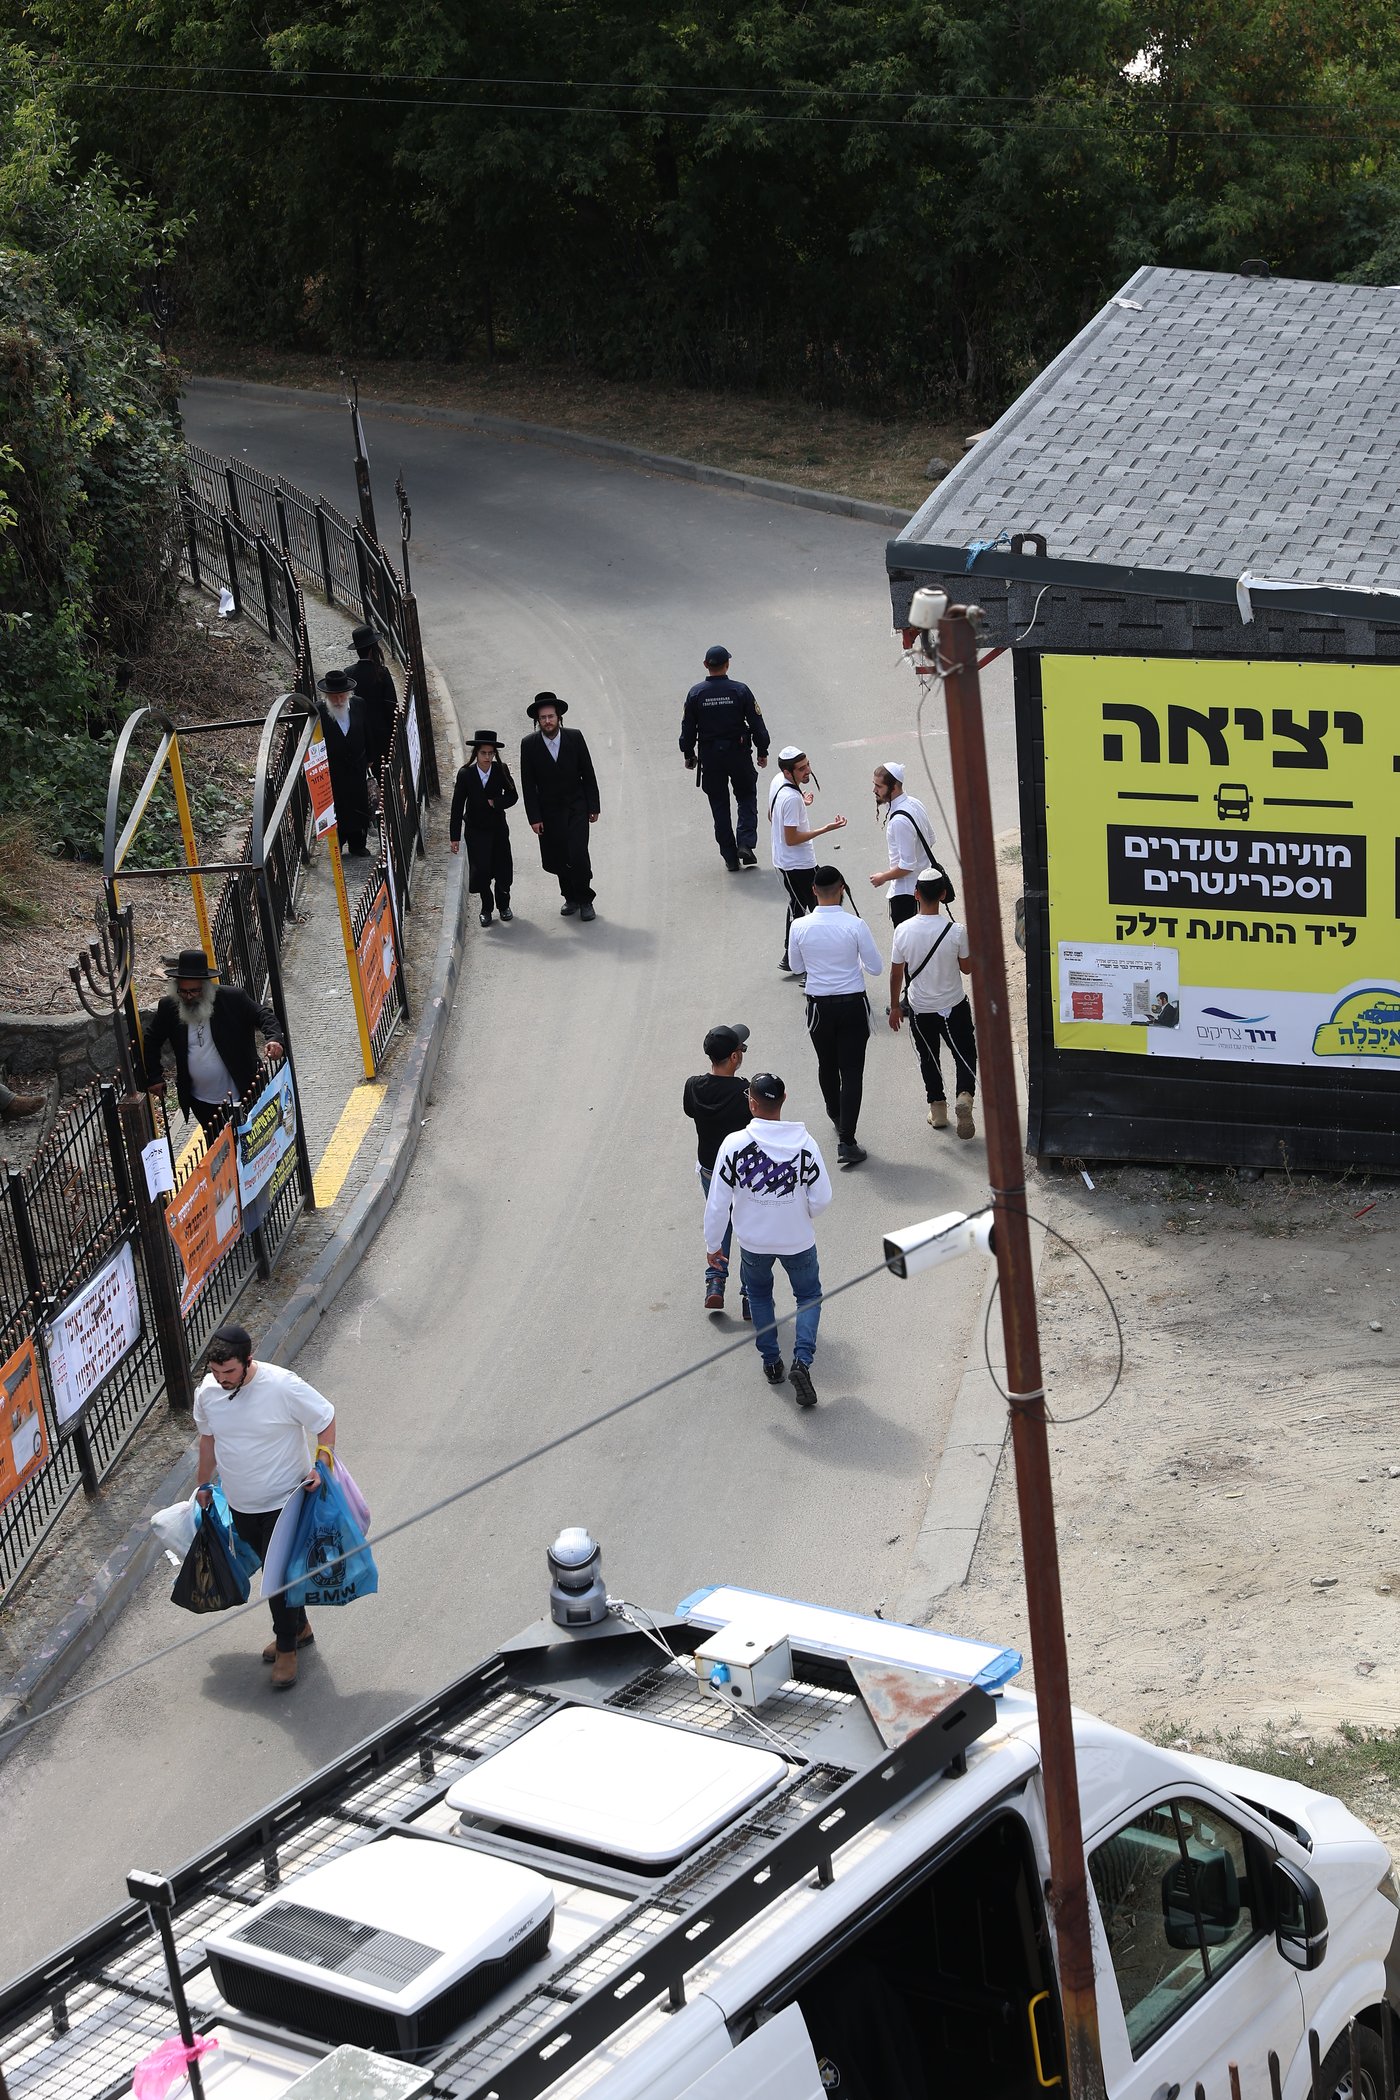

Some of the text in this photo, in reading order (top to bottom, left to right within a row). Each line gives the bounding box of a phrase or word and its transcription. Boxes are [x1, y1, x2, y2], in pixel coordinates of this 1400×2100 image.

[1102, 703, 1364, 769] יציאה
[1124, 836, 1352, 868] מוניות טנדרים
[1144, 869, 1333, 900] וספרינטרים
[1116, 912, 1357, 947] ליד התחנת דלק
[1196, 1025, 1277, 1043] דרך צדיקים
[305, 1582, 356, 1604] BMW
